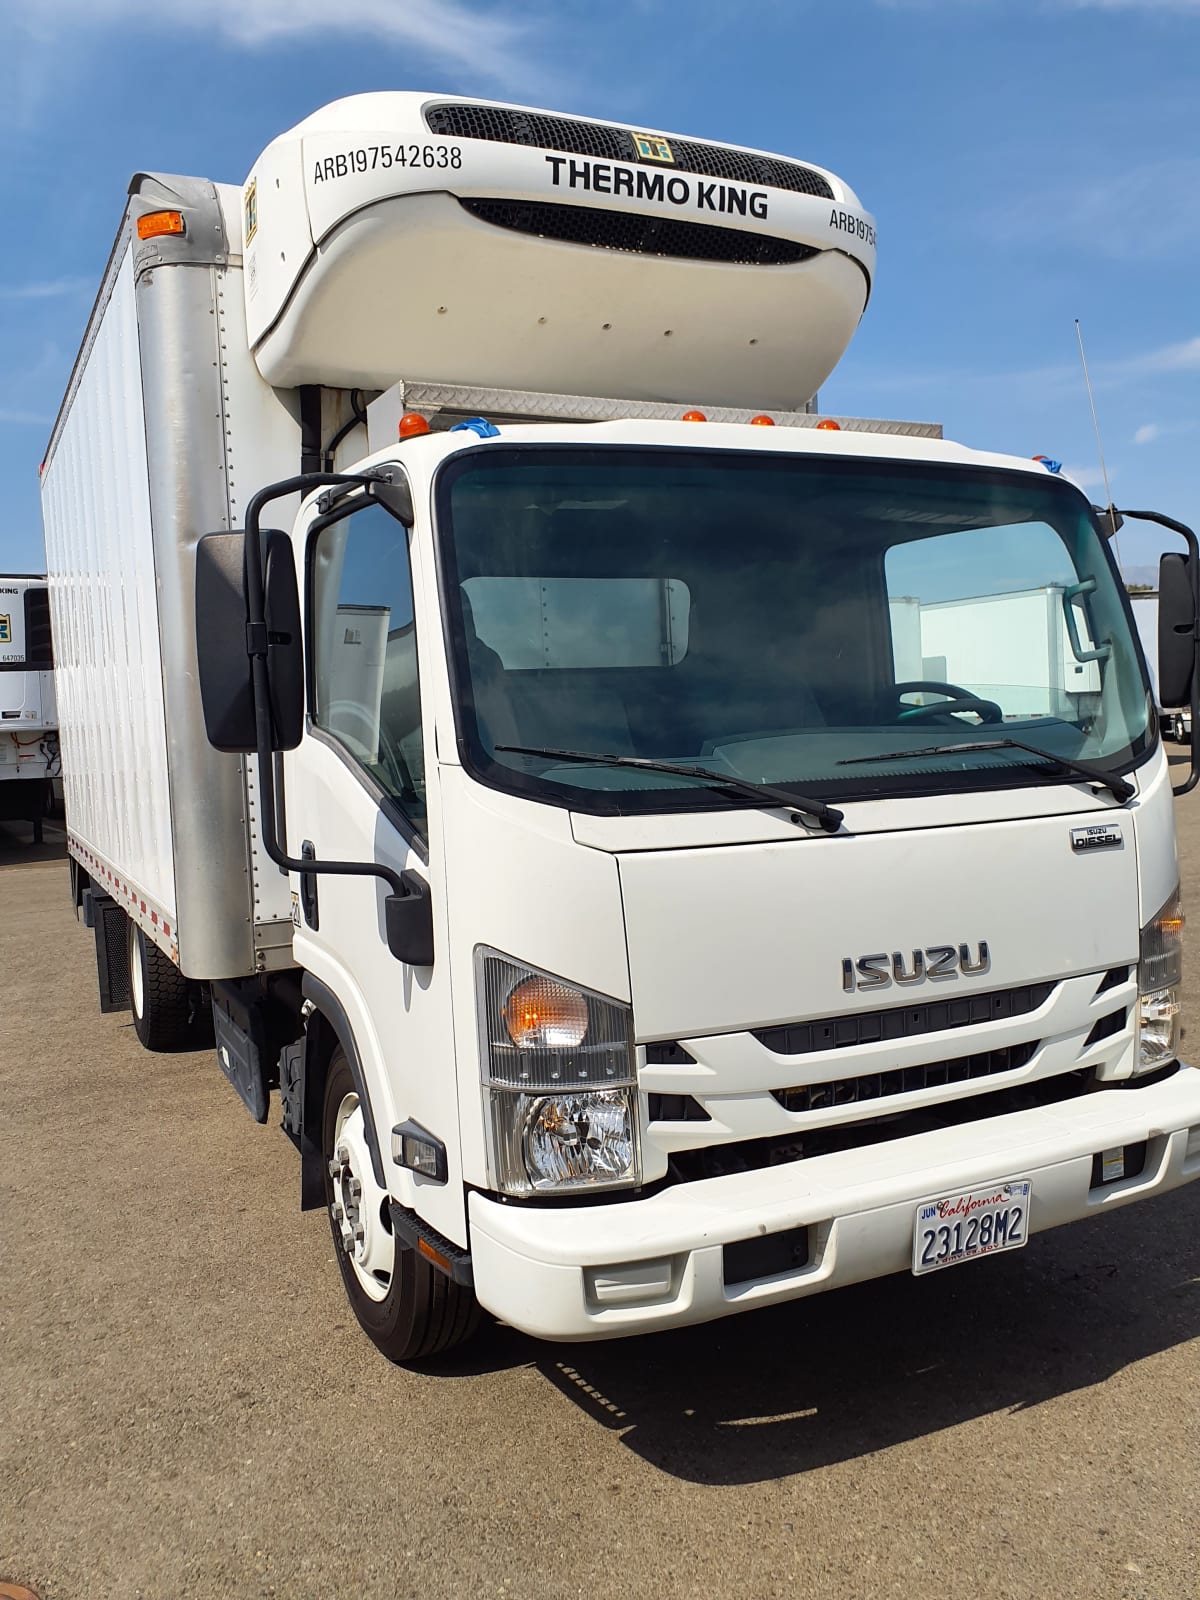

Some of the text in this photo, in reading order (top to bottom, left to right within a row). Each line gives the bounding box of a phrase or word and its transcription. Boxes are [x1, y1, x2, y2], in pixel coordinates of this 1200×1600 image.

[314, 144, 462, 184] ARB197542638
[545, 155, 768, 220] THERMO KING
[1075, 834, 1121, 849] DIESEL
[1086, 827, 1107, 836] ISUZU
[842, 939, 989, 992] ISUZU
[921, 1206, 936, 1220] JUN
[939, 1194, 1010, 1219] California
[921, 1207, 1022, 1265] 23128M2
